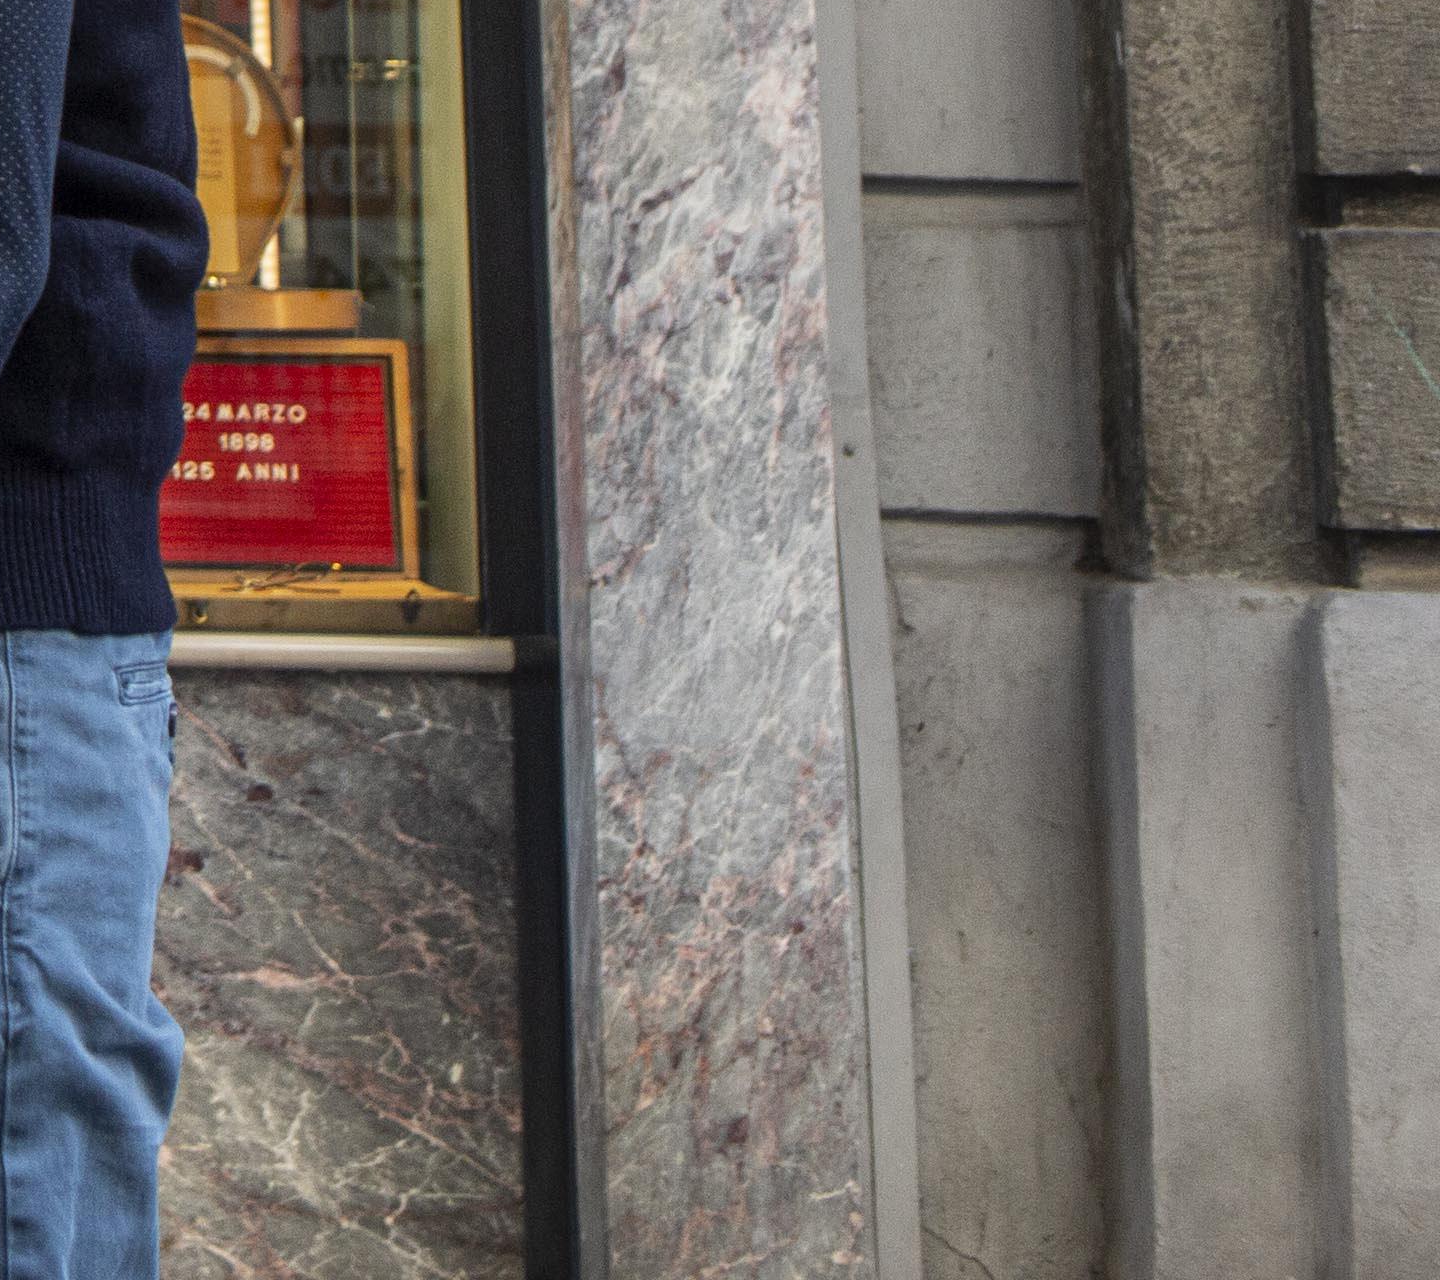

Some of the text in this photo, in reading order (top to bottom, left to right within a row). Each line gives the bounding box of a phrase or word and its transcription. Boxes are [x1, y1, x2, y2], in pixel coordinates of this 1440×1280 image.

[182, 402, 308, 425] 24 MARZO
[171, 460, 301, 482] 125 ANNI
